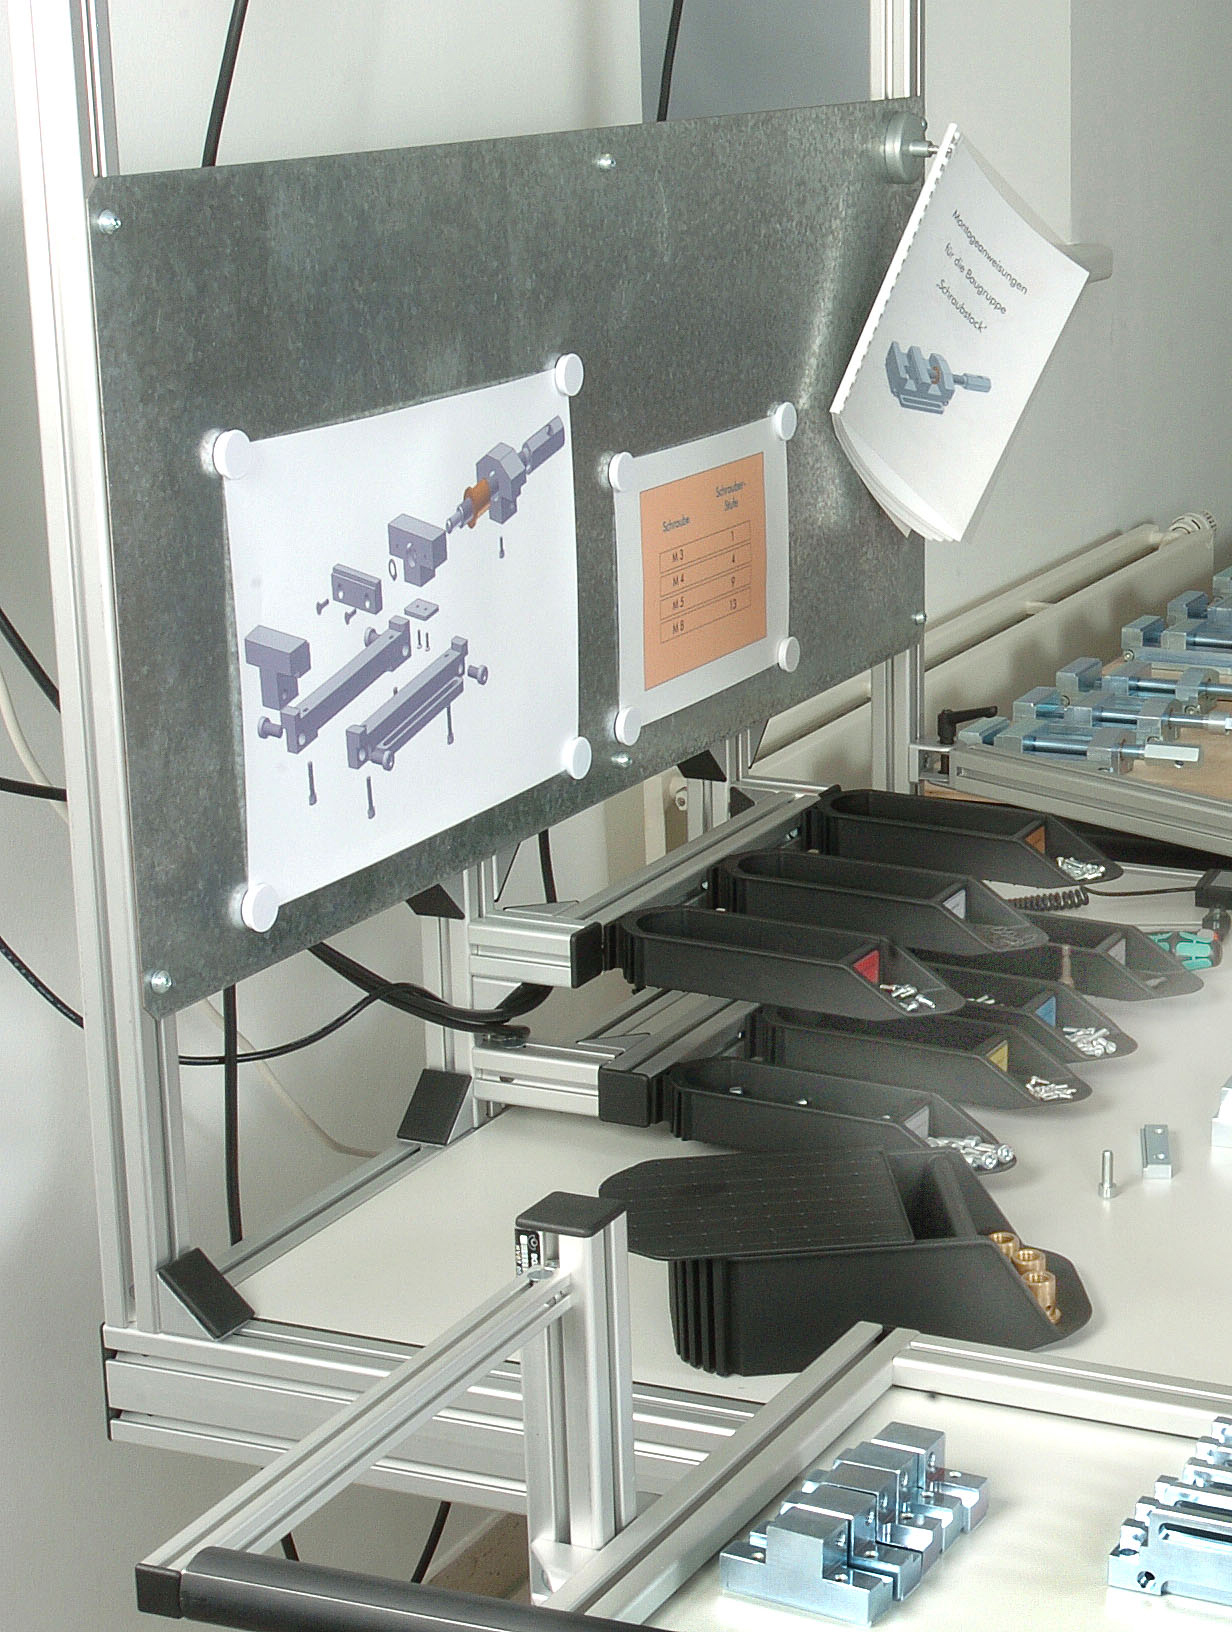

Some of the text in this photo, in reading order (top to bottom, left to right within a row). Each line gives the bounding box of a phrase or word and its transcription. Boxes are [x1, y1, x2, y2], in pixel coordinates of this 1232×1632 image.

[952, 208, 1028, 295] Montageanweisungen
[945, 242, 1007, 314] für die Baugruppe
[662, 514, 690, 533] Schraube
[672, 552, 679, 563] M
[672, 576, 679, 586] M
[672, 599, 679, 609] M
[680, 596, 685, 608] 5
[672, 623, 679, 634] M
[730, 598, 737, 610] 13
